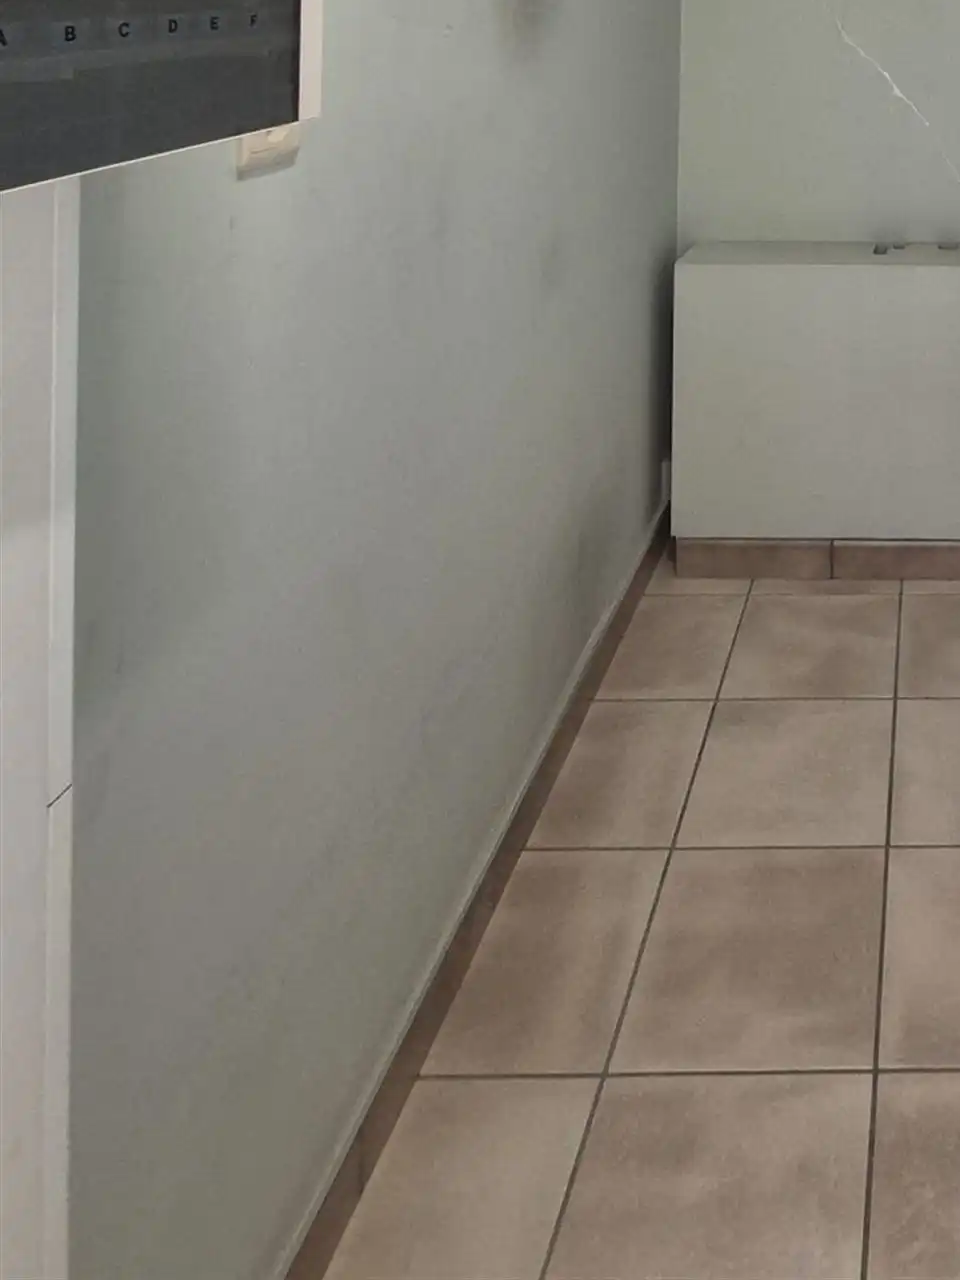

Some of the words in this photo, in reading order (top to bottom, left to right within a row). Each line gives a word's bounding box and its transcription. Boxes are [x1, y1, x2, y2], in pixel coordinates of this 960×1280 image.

[64, 25, 76, 42] B
[118, 22, 130, 38] C
[168, 18, 179, 34] D
[209, 16, 219, 31] E
